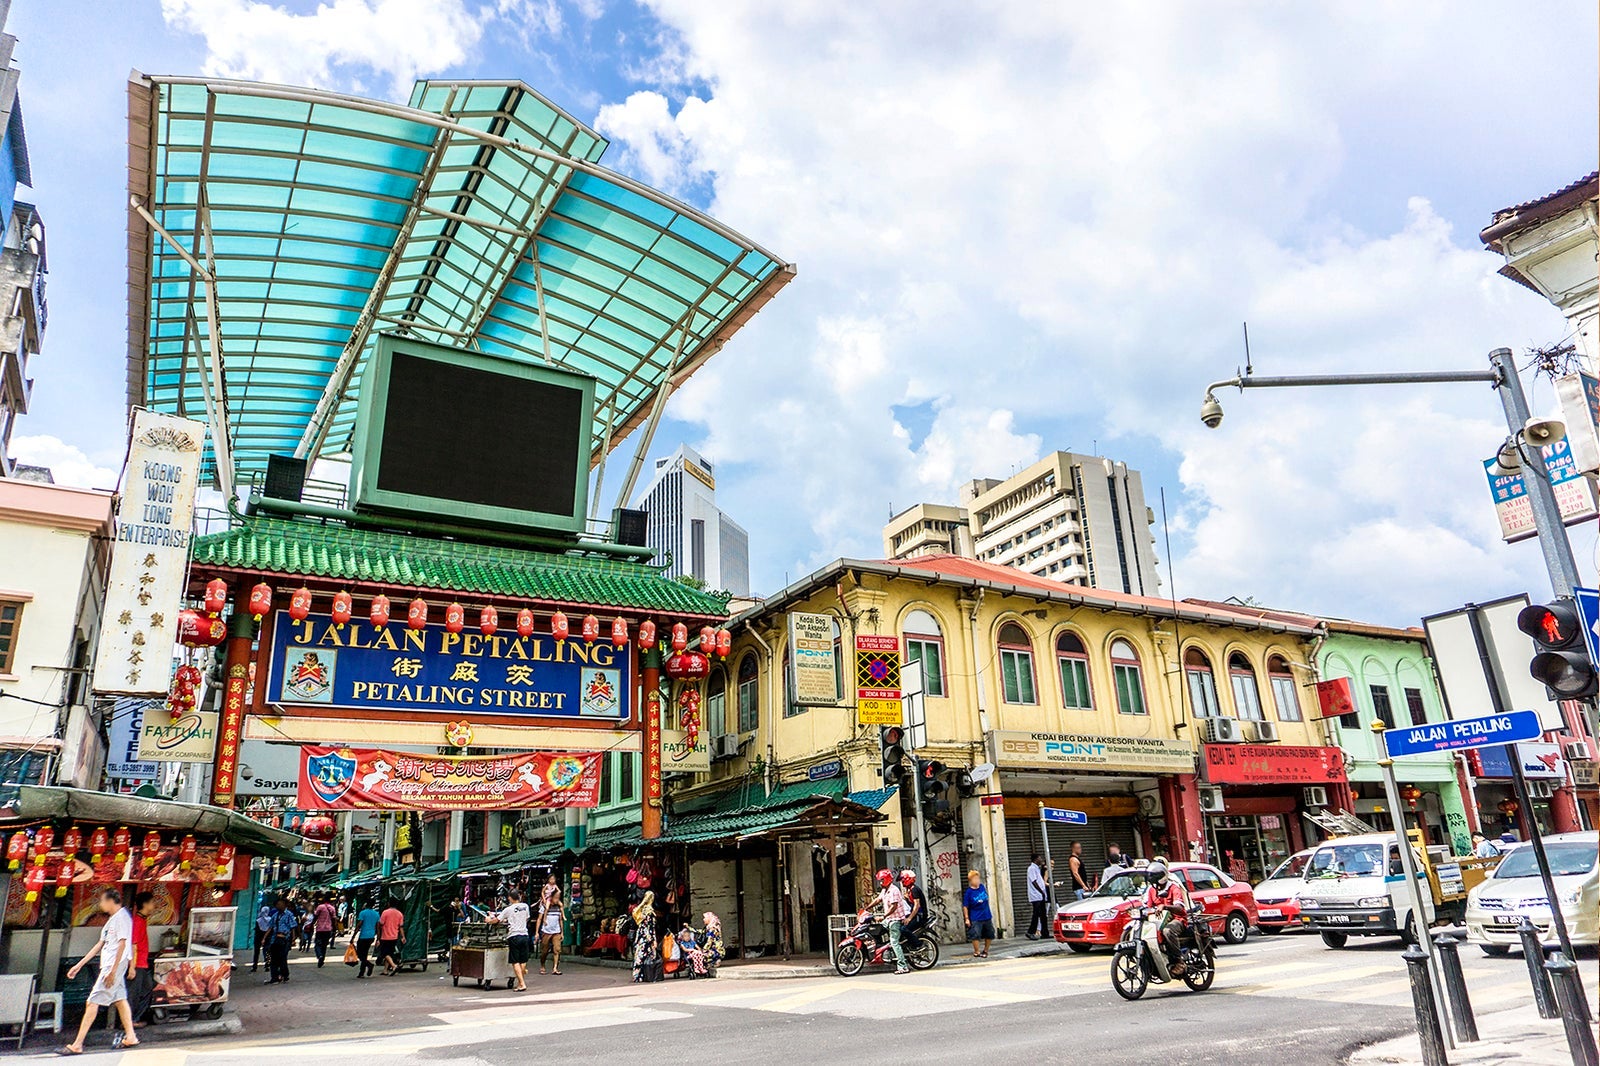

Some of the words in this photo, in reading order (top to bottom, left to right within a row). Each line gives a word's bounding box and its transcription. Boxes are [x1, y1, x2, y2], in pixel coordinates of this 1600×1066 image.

[147, 482, 175, 504] WOH
[143, 503, 172, 525] TONG
[118, 523, 188, 549] ENTERPRISE
[294, 620, 428, 653] JALAN
[438, 631, 615, 666] PETALING
[352, 681, 474, 705] PETALING
[480, 688, 567, 709] STREET
[864, 701, 879, 709] KOD
[145, 725, 213, 739] FATTUAH
[1408, 727, 1447, 744] JALAN
[1453, 717, 1513, 738] PETALING
[663, 743, 707, 753] FATTAH
[1004, 742, 1039, 752] DES
[1031, 733, 1056, 741] KEDAI
[1058, 734, 1075, 742] BEG
[1077, 735, 1094, 743] DAN
[1096, 736, 1135, 745] AKSESORI
[1136, 738, 1165, 747] WANITA
[140, 749, 164, 757] GROUP
[175, 751, 212, 759] COMPANIES
[382, 779, 426, 795] Happy
[427, 779, 468, 793] Chinese
[468, 779, 493, 792] New
[491, 779, 523, 796] Year
